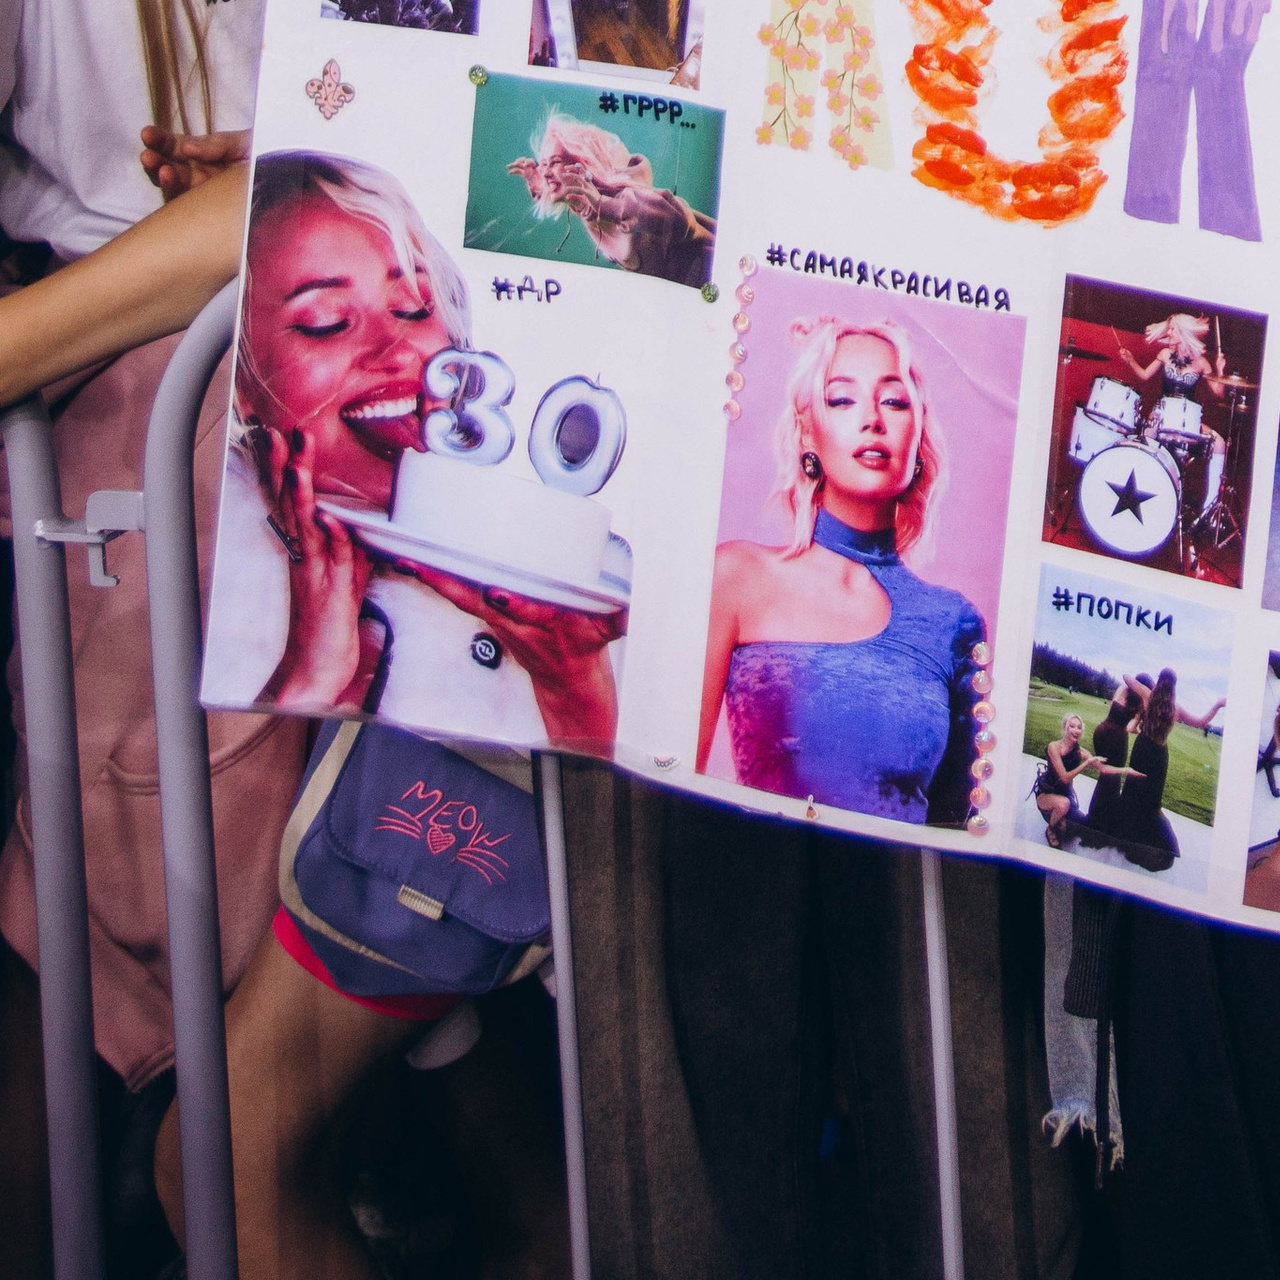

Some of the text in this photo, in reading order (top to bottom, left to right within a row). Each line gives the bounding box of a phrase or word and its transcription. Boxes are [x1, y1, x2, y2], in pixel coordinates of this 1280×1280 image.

[765, 241, 1011, 312] #САМАЯКРАСИВАЯ
[1051, 585, 1174, 636] #ПОПКИ
[401, 780, 513, 849] MEOW
